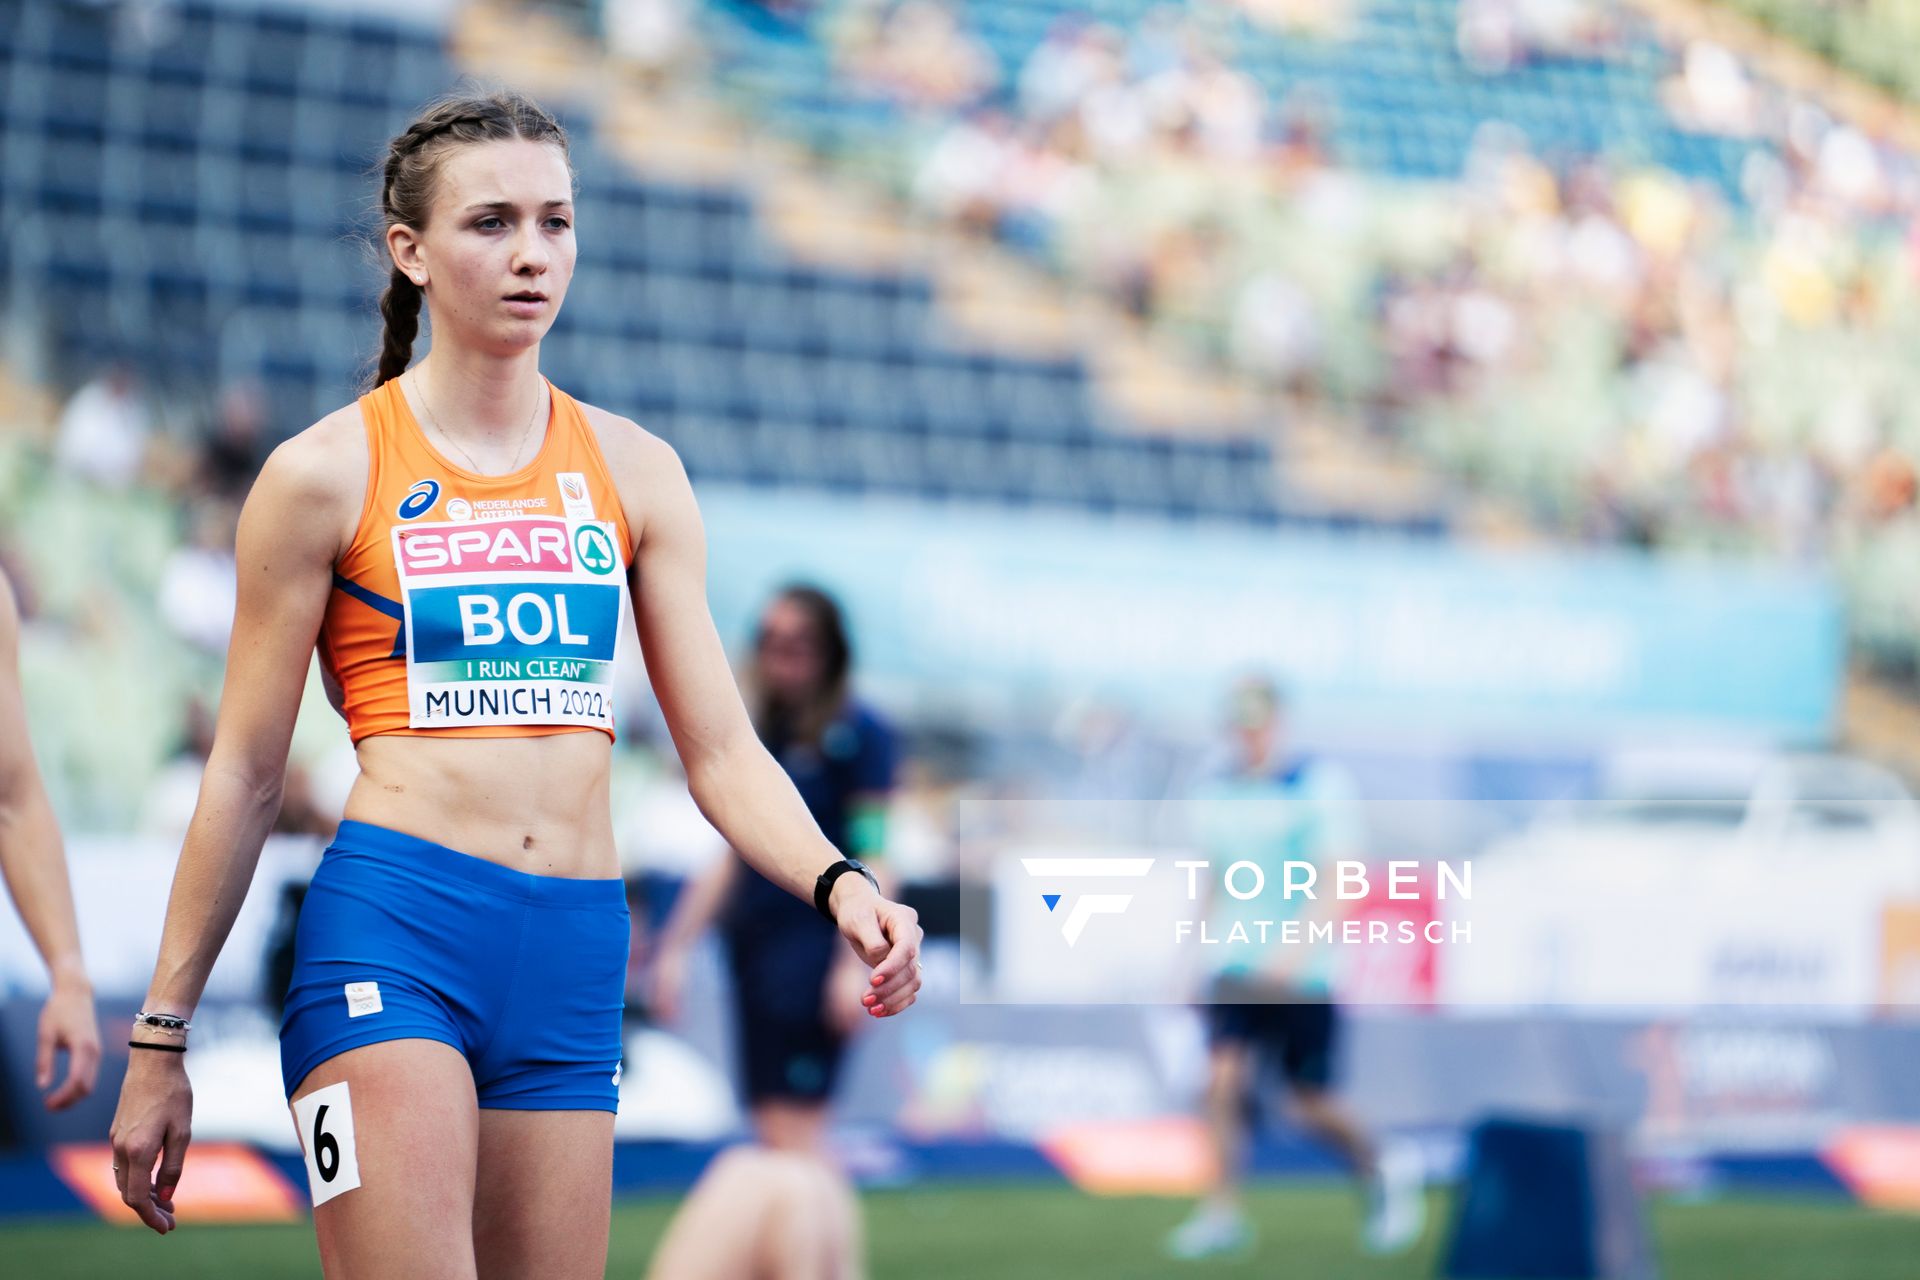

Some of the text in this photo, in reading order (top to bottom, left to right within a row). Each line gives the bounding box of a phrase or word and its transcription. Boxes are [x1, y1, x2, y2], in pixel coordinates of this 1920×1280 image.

[473, 498, 547, 510] NEDERLANDSE
[404, 527, 568, 568] SPAR
[458, 592, 589, 646] BOL
[467, 661, 472, 678] I
[480, 661, 520, 678] RUN
[426, 688, 606, 718] MUNICH 2022
[313, 1104, 340, 1183] 6
